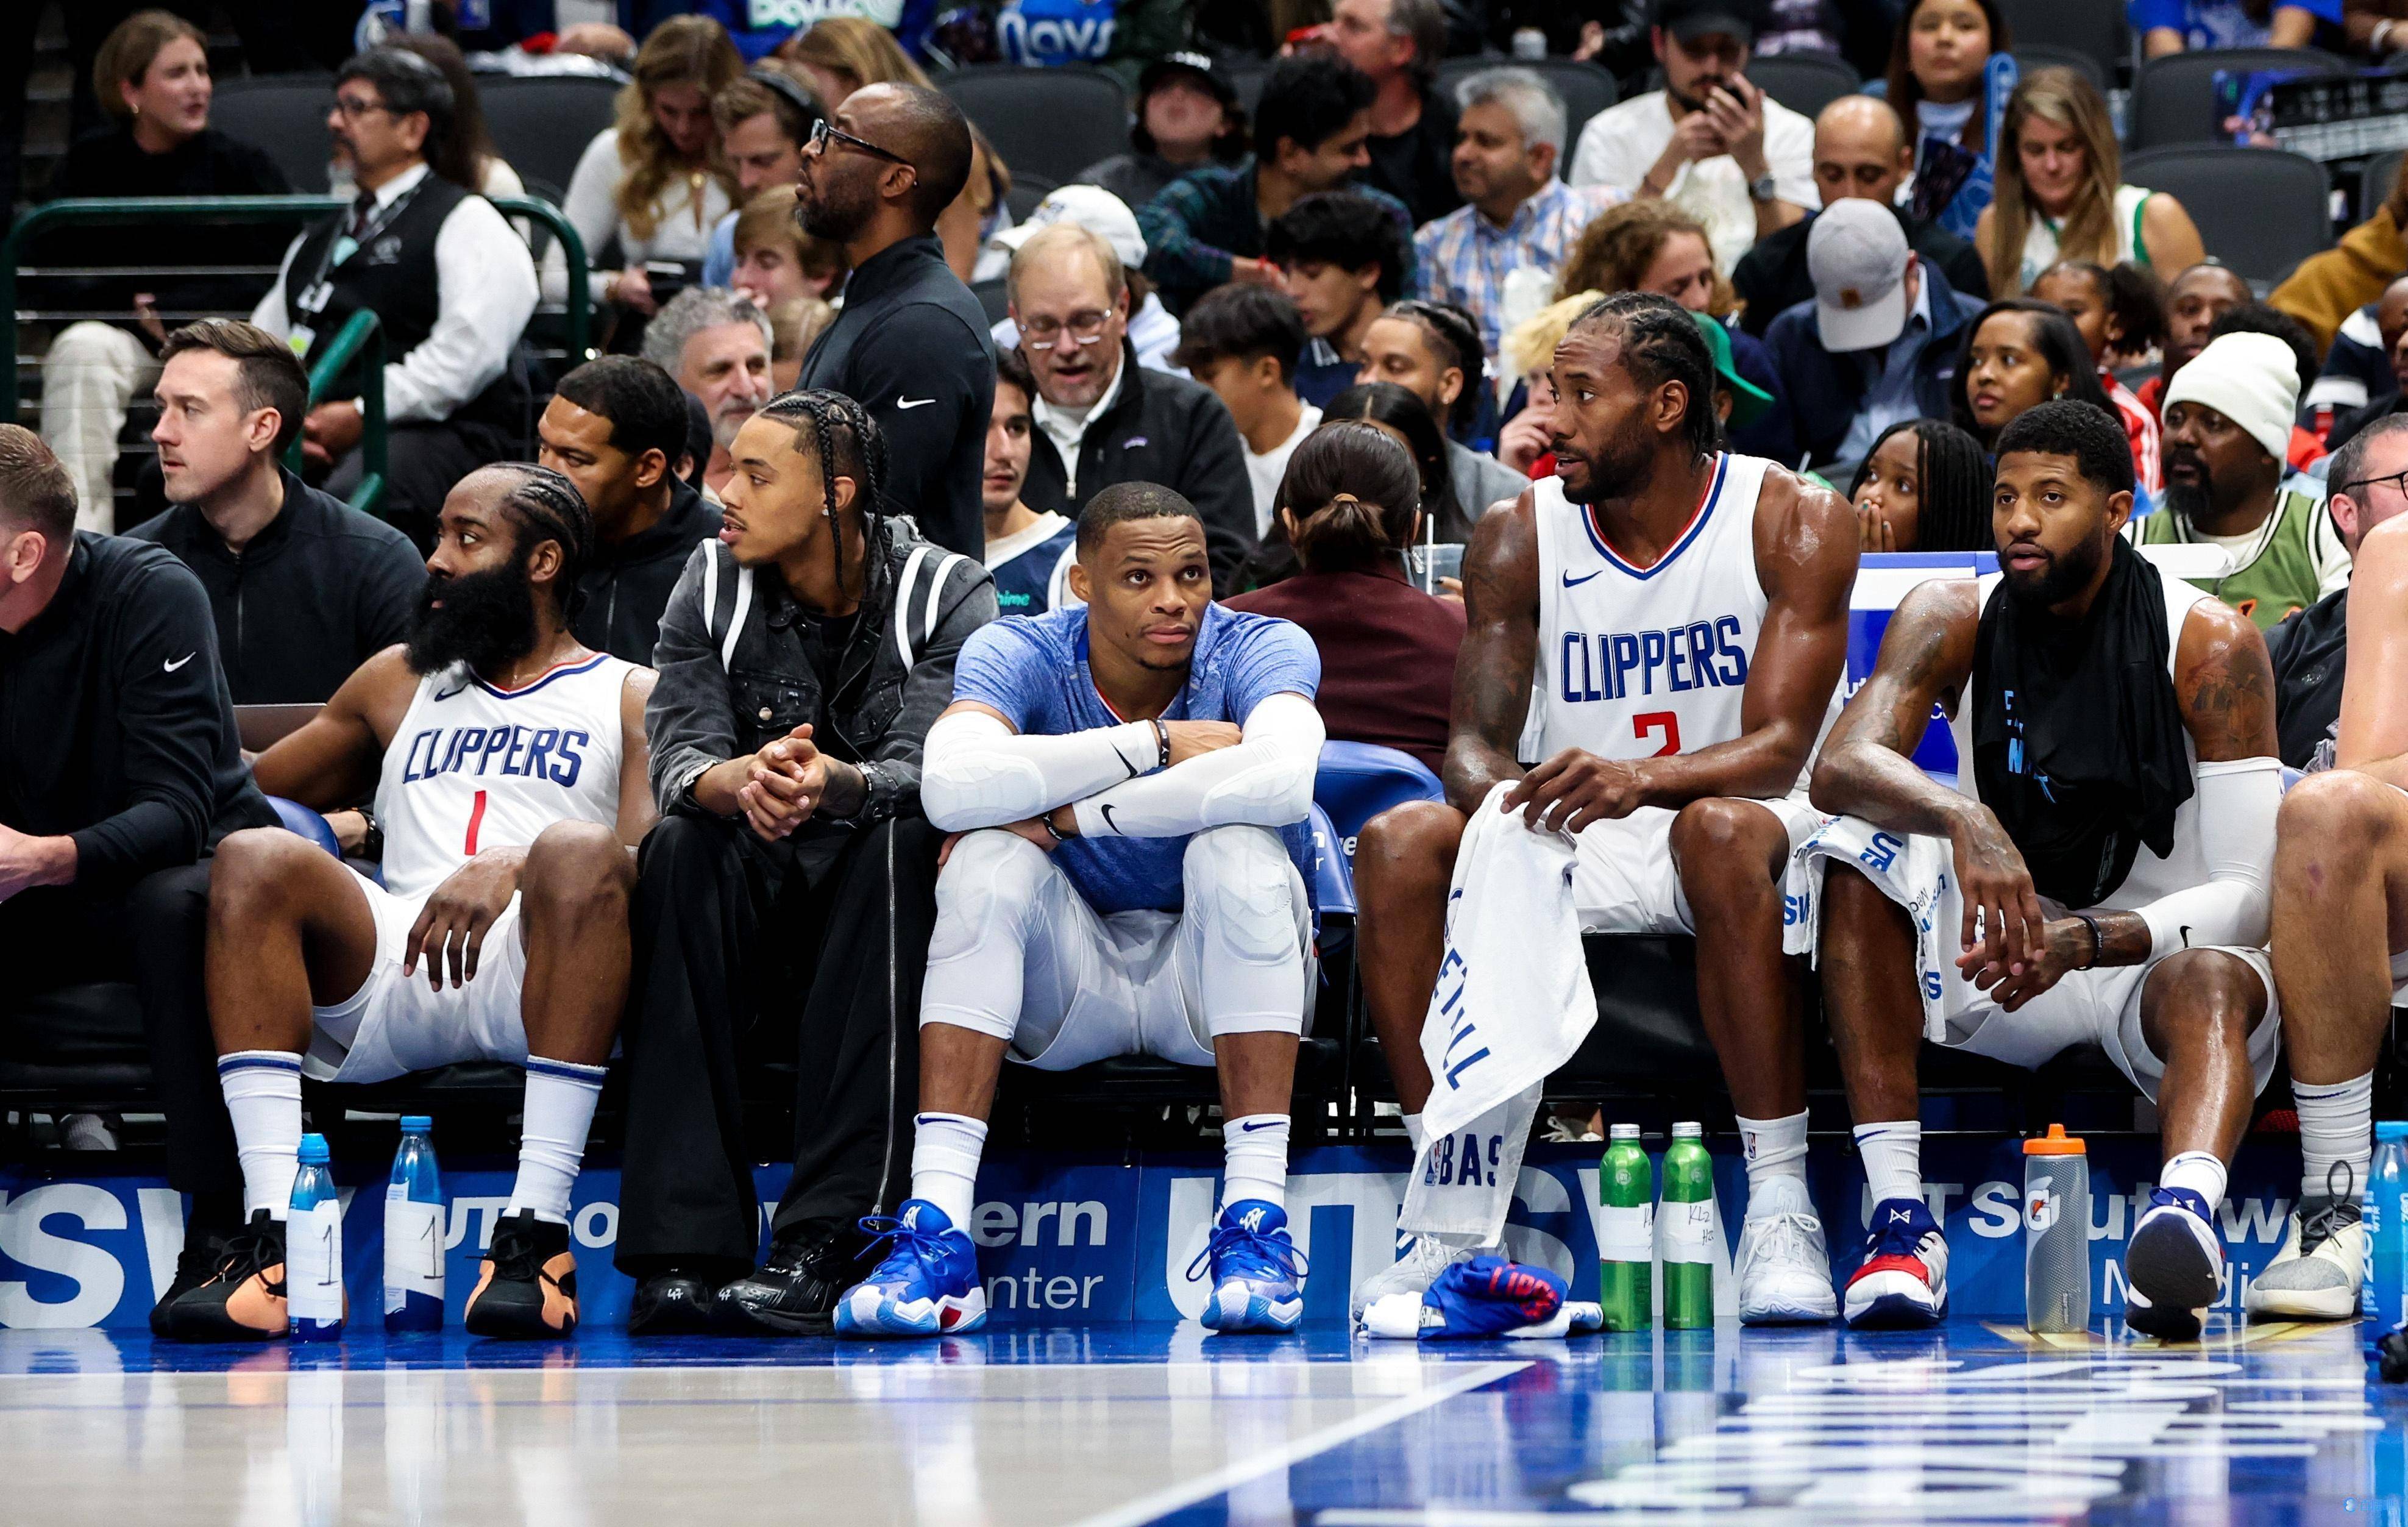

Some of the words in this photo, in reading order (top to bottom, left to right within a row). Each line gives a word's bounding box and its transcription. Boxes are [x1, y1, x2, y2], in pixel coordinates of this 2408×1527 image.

[1561, 614, 1749, 702] CLIPPERS
[402, 724, 589, 788] CLIPPERS
[464, 790, 486, 856] 1
[318, 1224, 339, 1286] 1
[421, 1215, 445, 1280] 1
